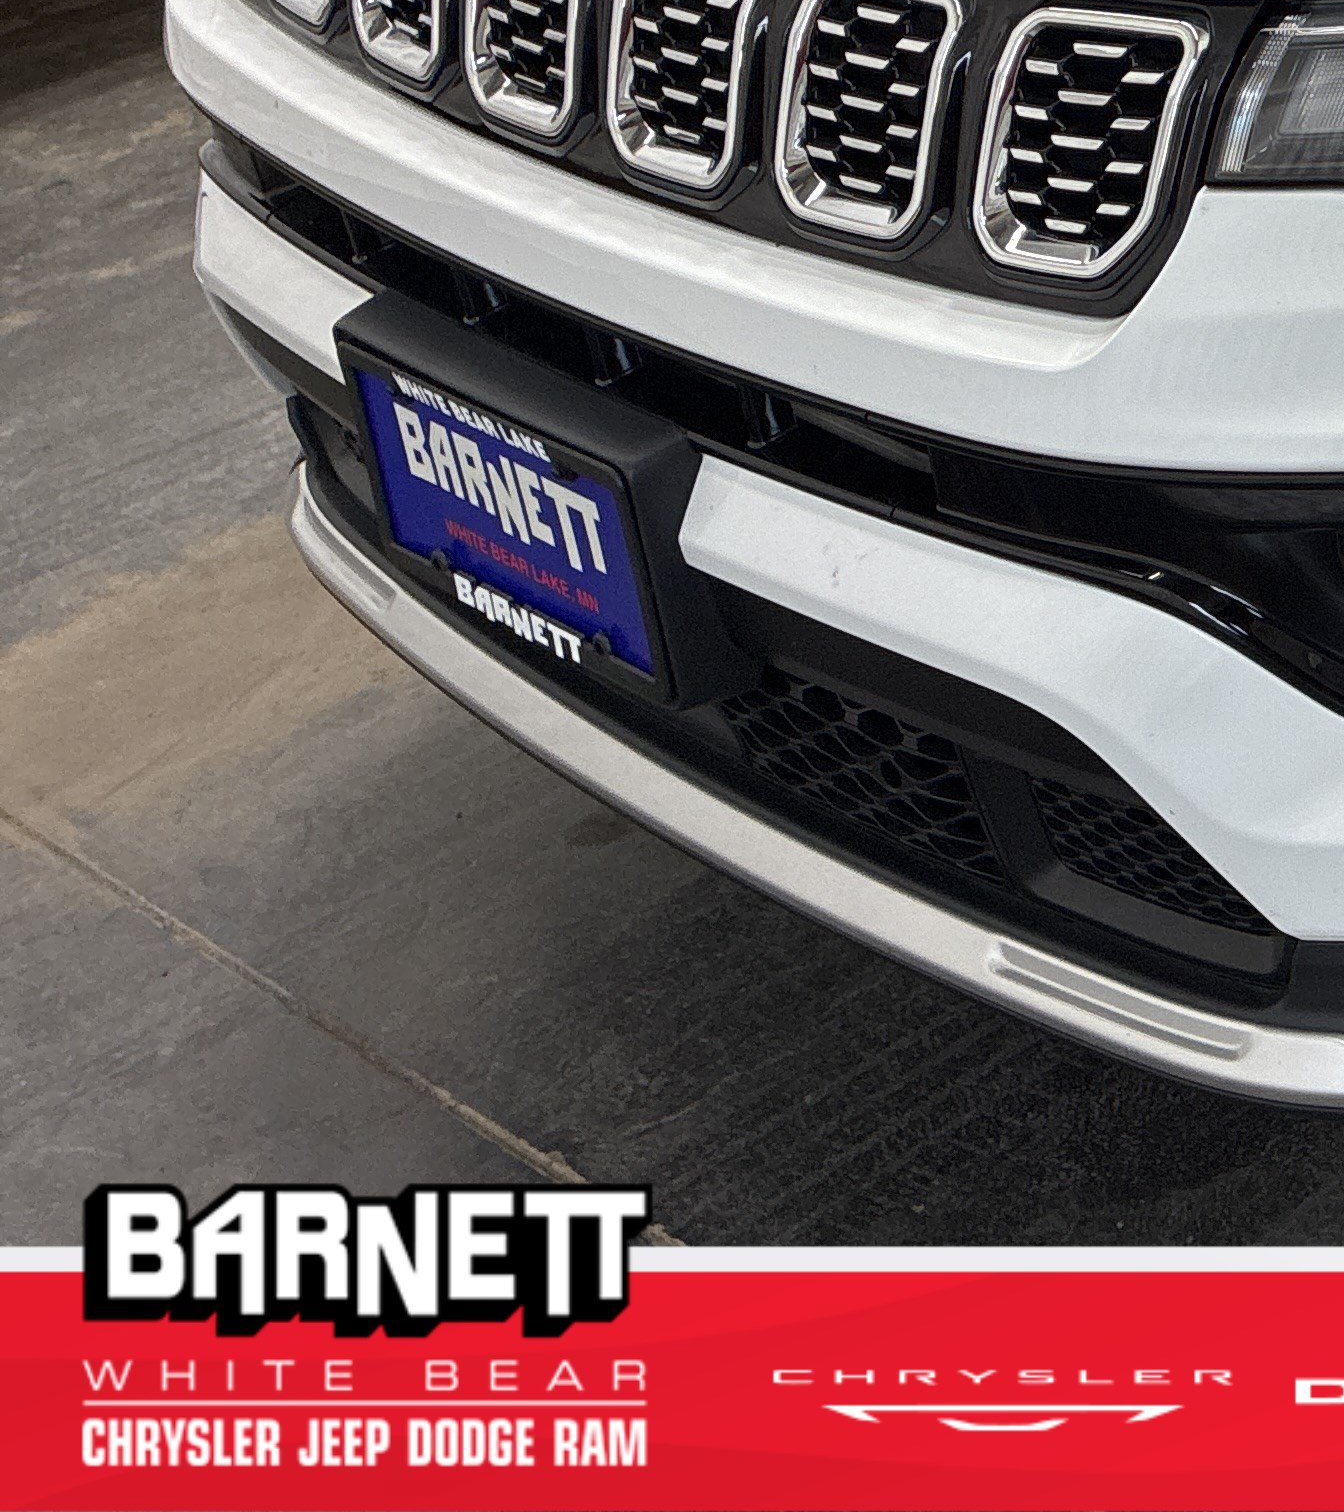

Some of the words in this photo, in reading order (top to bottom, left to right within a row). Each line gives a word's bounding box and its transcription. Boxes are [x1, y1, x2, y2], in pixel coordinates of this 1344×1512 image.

[391, 371, 452, 417] WHITE
[447, 399, 501, 441] BEAR
[497, 422, 551, 463] LAKE
[392, 401, 608, 575] BARNETT
[444, 517, 488, 555] WHITE
[490, 540, 530, 578] BEAR
[576, 587, 600, 614] MN
[453, 572, 582, 665] BARNETT
